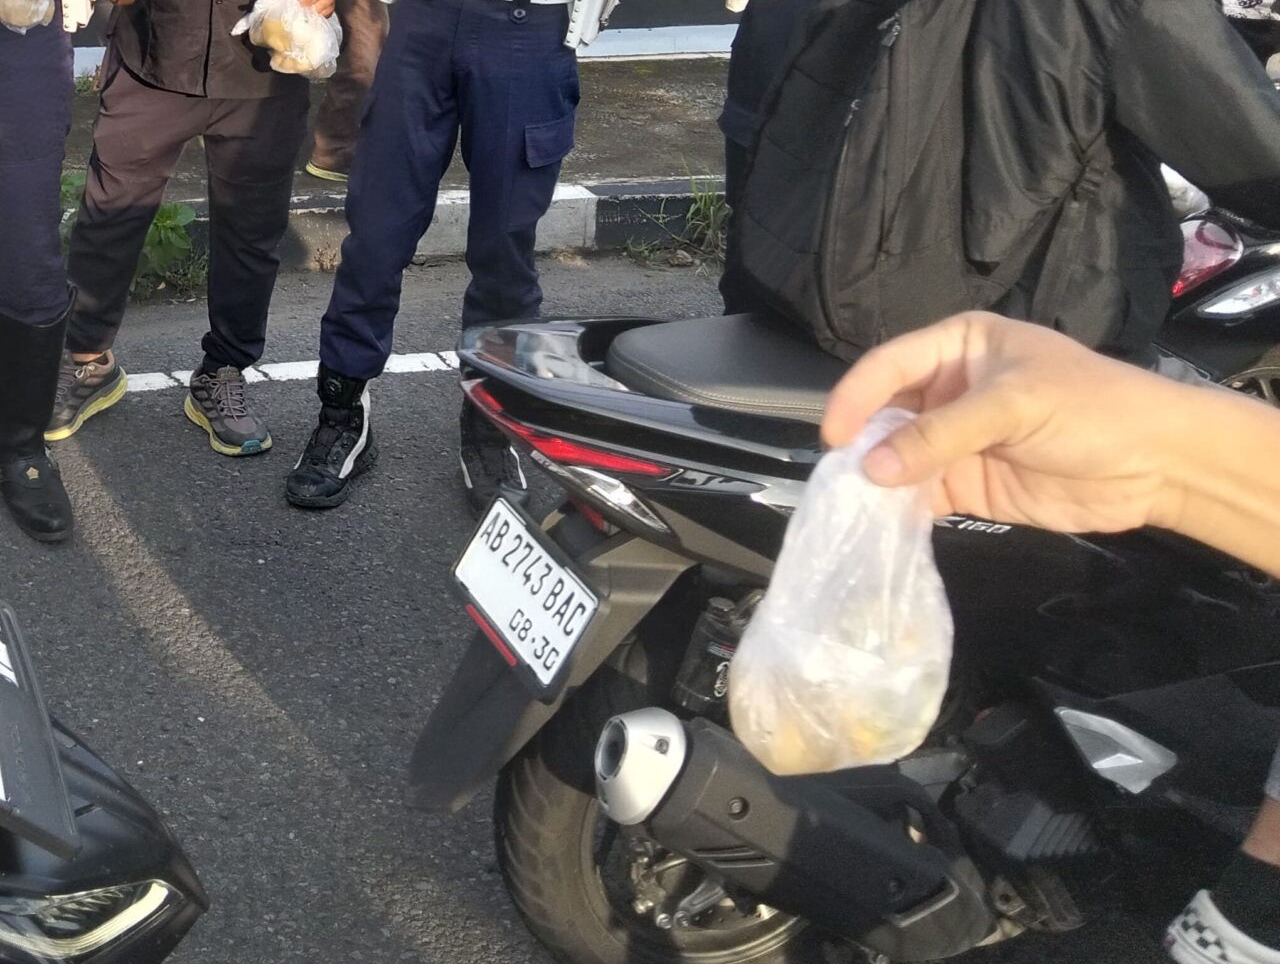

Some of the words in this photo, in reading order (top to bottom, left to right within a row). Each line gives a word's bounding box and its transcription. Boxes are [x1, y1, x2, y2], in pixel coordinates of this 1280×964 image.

[480, 511, 510, 552] AB
[502, 534, 553, 595] 2743
[543, 577, 587, 636] BAC
